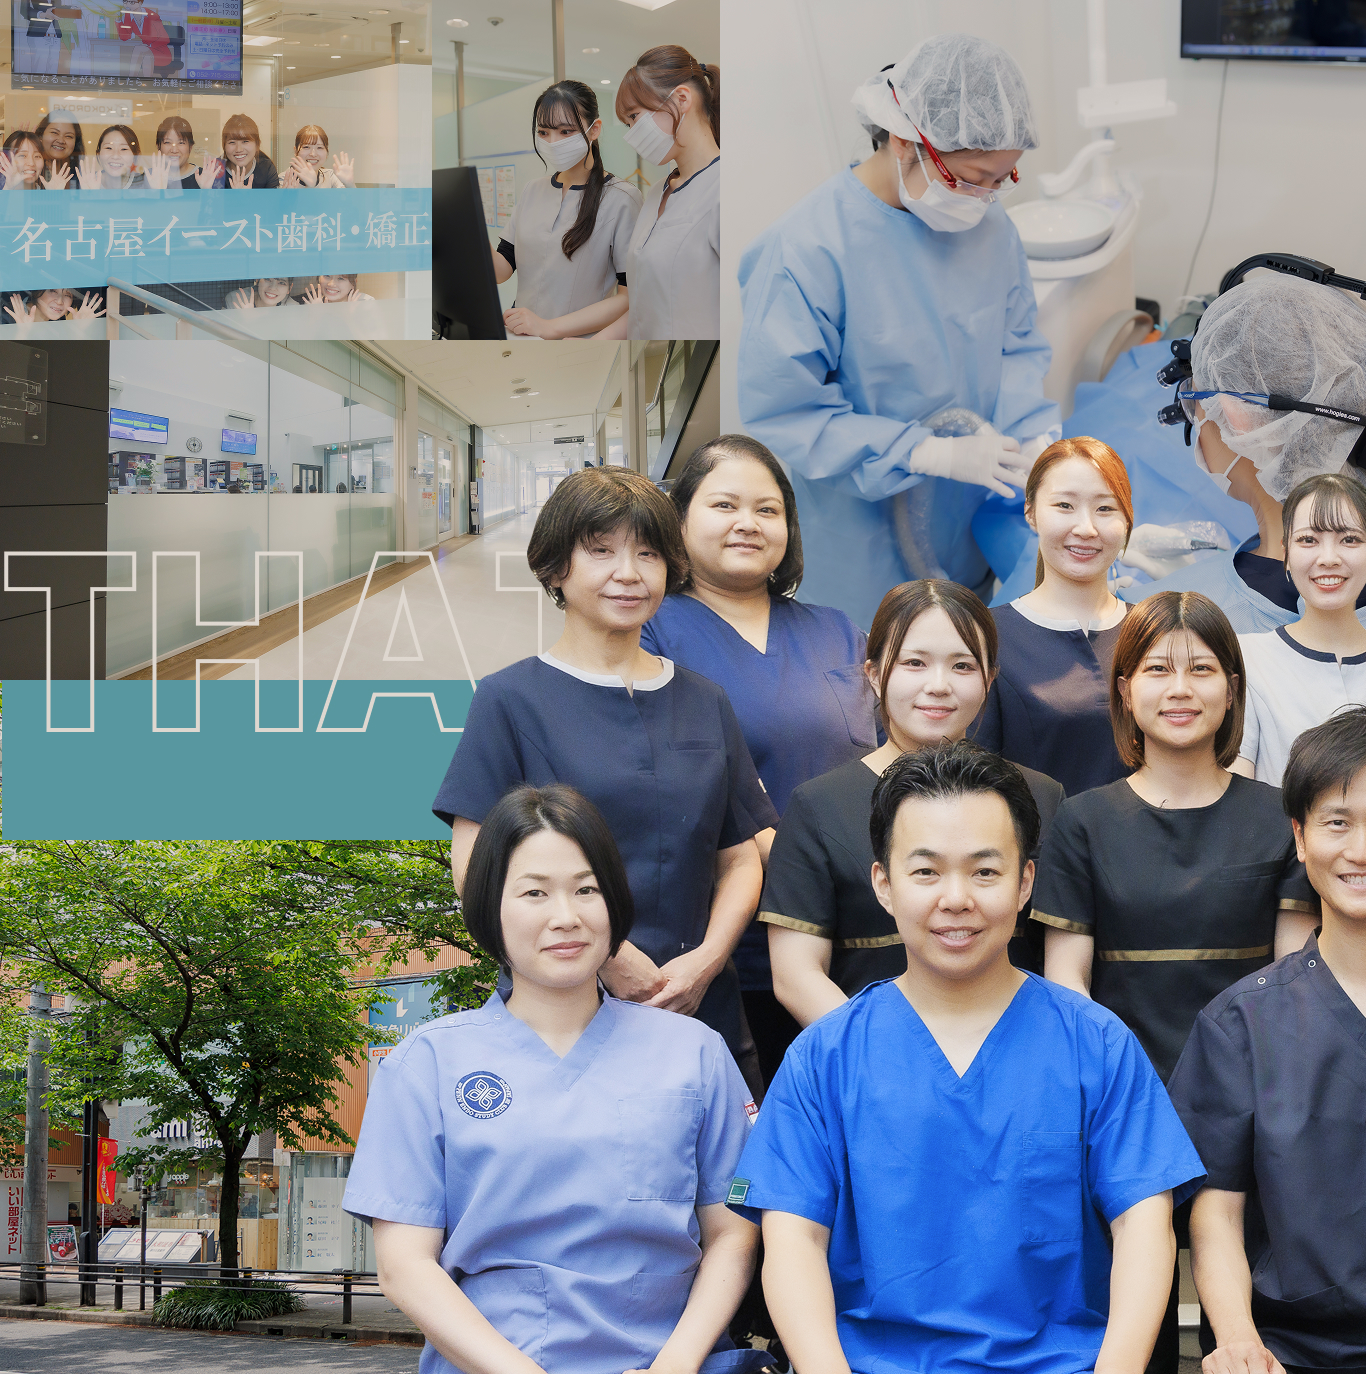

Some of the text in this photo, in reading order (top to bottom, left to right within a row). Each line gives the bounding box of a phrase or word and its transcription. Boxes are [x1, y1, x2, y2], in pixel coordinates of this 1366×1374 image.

[10, 211, 431, 264] 名古屋イースト歯科・矯正
[1315, 406, 1361, 422] www.hogies.com
[8, 1186, 20, 1255] いい部屋ネット
